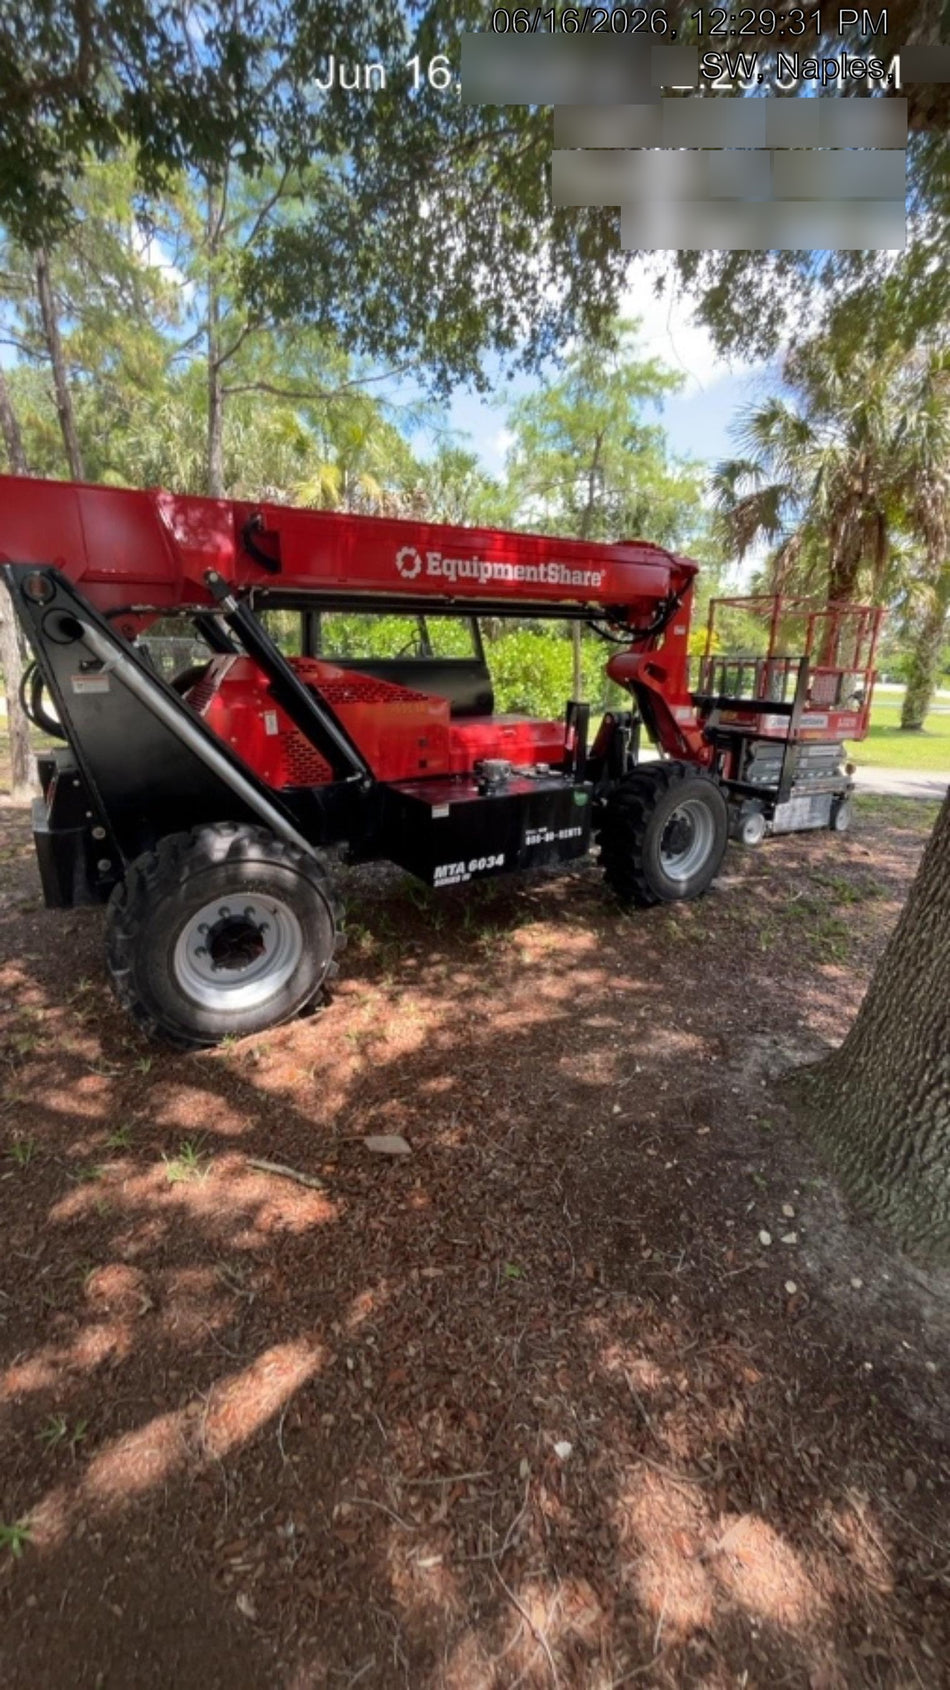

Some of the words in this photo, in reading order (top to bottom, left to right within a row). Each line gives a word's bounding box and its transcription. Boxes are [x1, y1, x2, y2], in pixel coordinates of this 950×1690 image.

[426, 552, 602, 587] EquipmentShare
[433, 861, 466, 880] MTA
[468, 853, 505, 872] 6034
